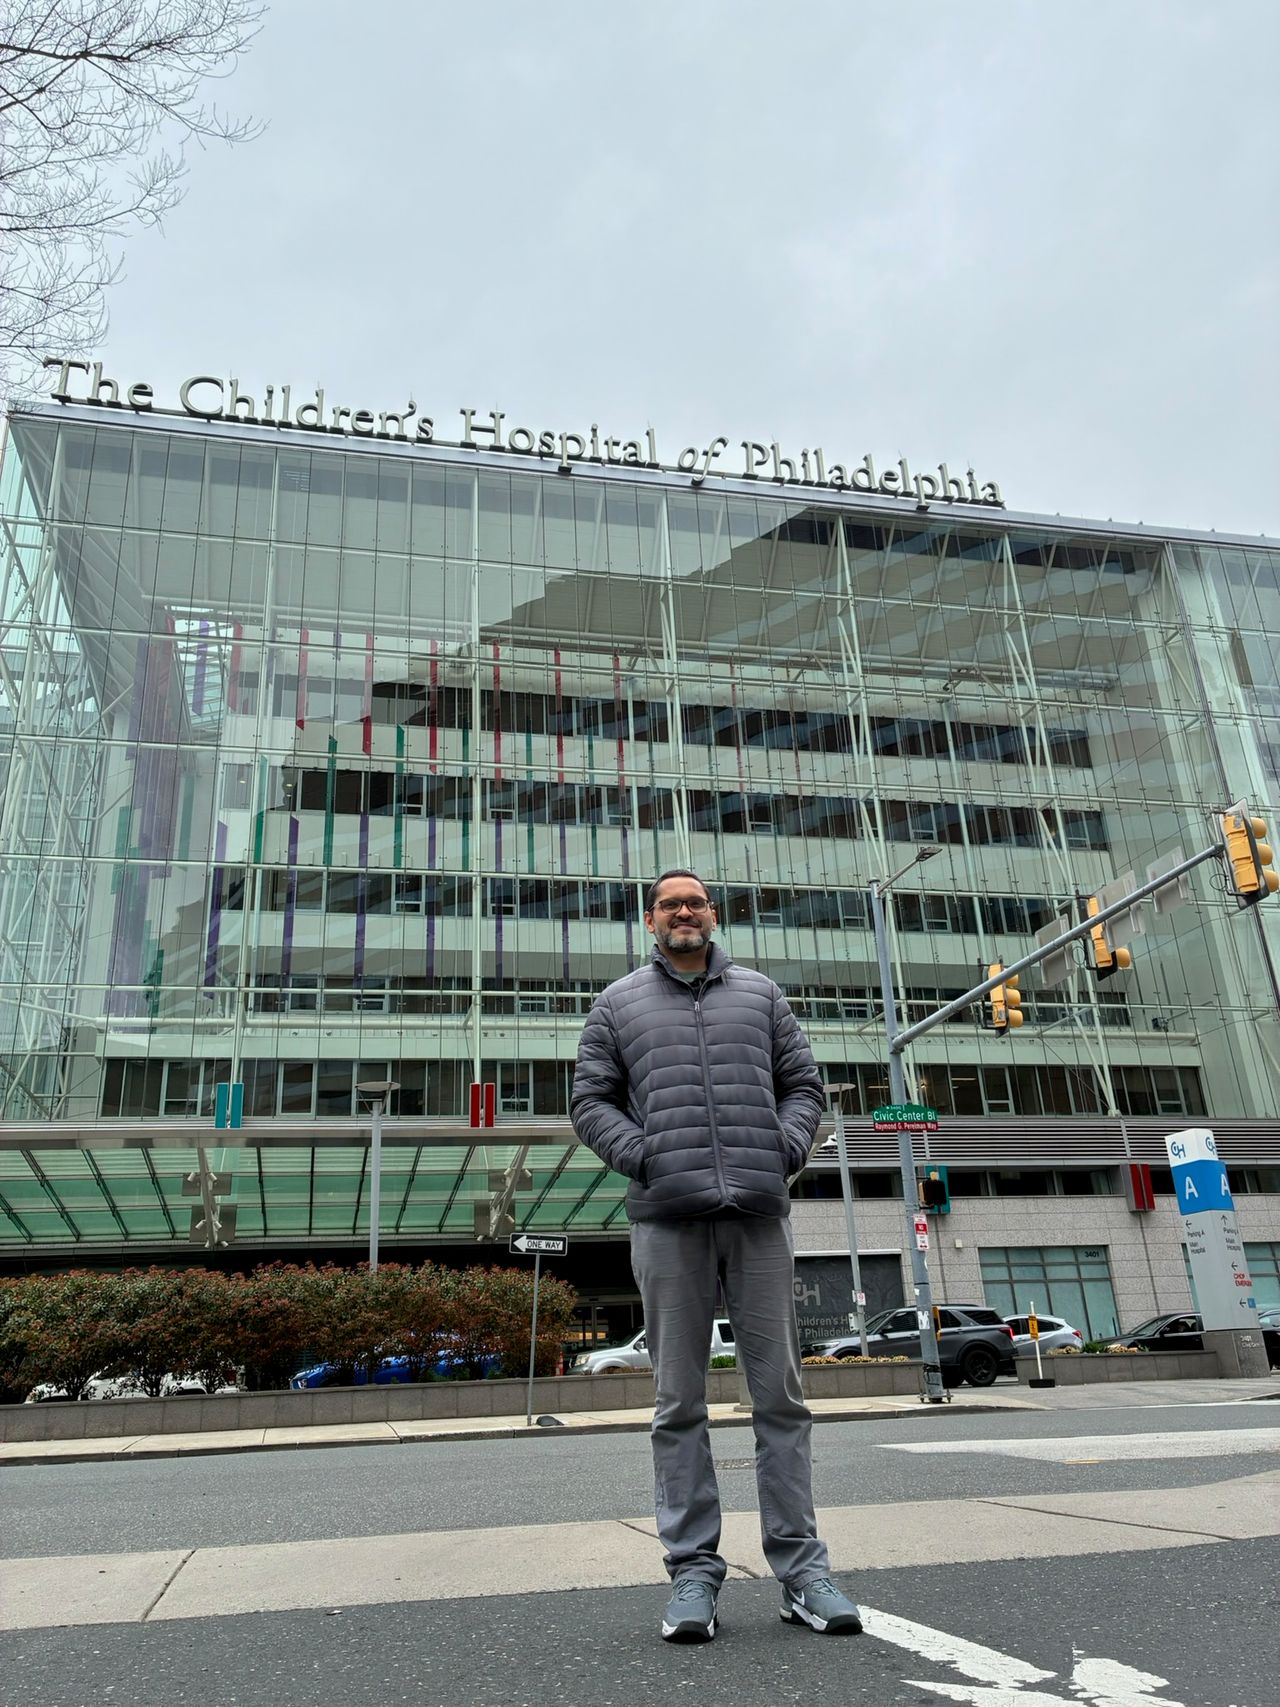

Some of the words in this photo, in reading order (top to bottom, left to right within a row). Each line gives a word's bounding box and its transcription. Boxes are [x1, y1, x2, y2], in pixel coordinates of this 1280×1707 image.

[43, 355, 153, 409] The
[180, 376, 433, 443] Children's
[460, 408, 659, 473] Hospital
[678, 436, 729, 486] of
[741, 440, 1006, 511] Philadelphia
[873, 1111, 894, 1121] Civic
[896, 1111, 925, 1121] Center
[927, 1111, 936, 1121] Bl
[1185, 1176, 1199, 1200] A
[1221, 1173, 1232, 1197] A
[527, 1241, 542, 1249] ONE
[544, 1241, 561, 1250] WAY
[798, 1315, 839, 1326] hildren's
